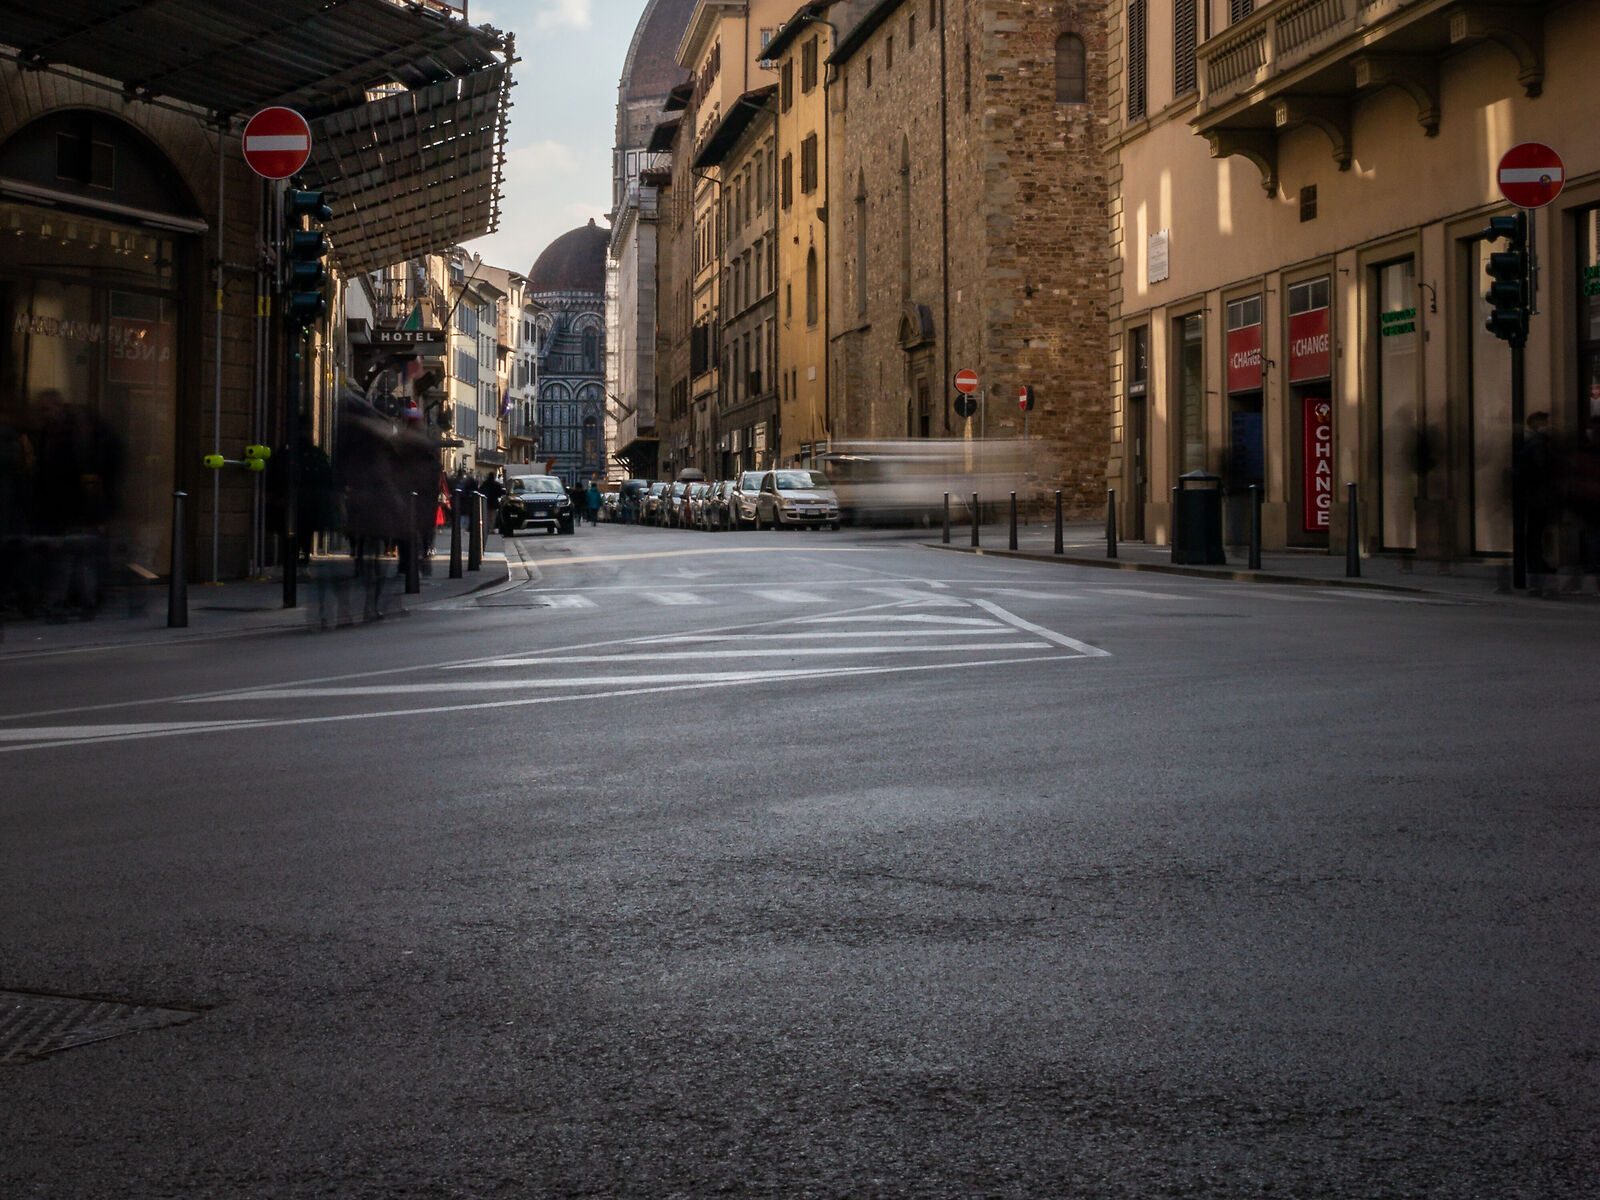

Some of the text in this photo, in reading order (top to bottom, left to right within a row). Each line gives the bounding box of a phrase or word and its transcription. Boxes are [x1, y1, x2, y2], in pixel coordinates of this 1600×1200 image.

[381, 332, 434, 342] HOTEL
[1295, 334, 1329, 357] CHANGE
[1315, 425, 1330, 526] CHANGE
